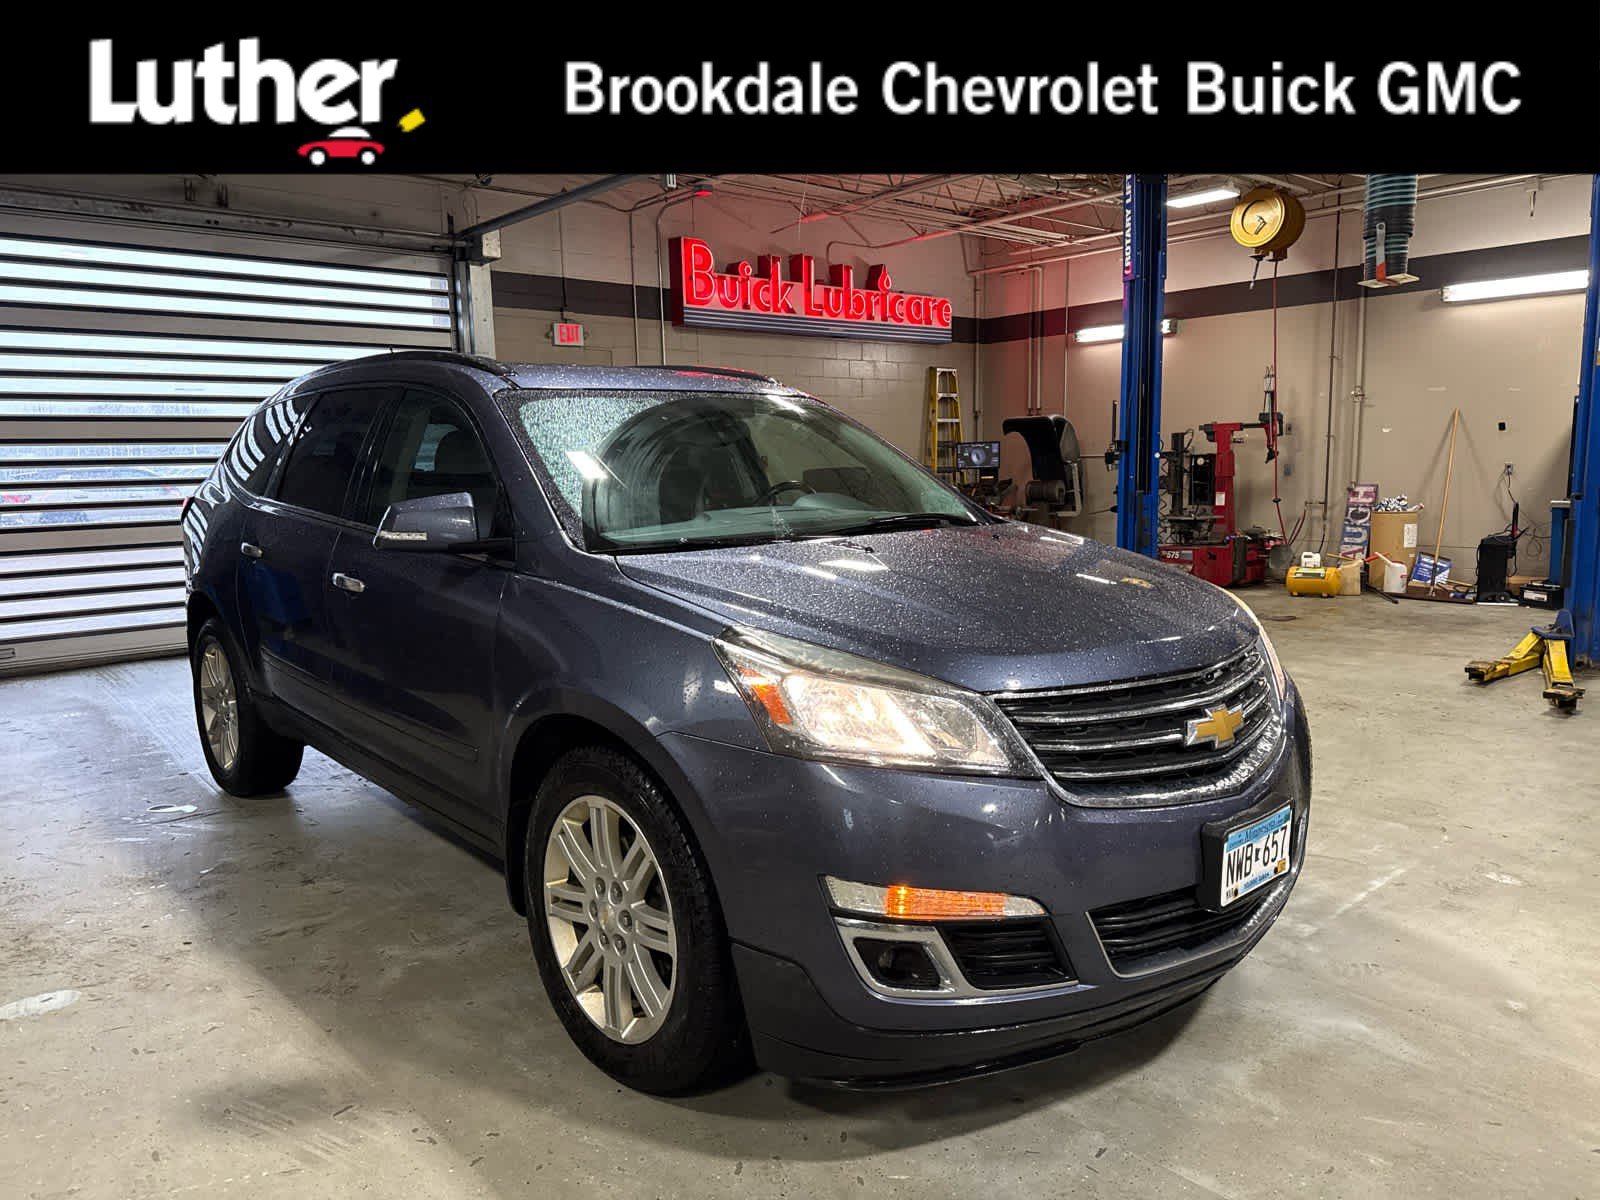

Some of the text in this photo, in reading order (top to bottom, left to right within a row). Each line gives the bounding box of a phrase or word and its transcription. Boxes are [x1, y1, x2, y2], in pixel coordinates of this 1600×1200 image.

[1124, 208, 1132, 267] ROTARY
[682, 237, 953, 328] Buick Lubricare
[558, 323, 580, 345] EXIT
[1226, 824, 1288, 889] NWB 657
